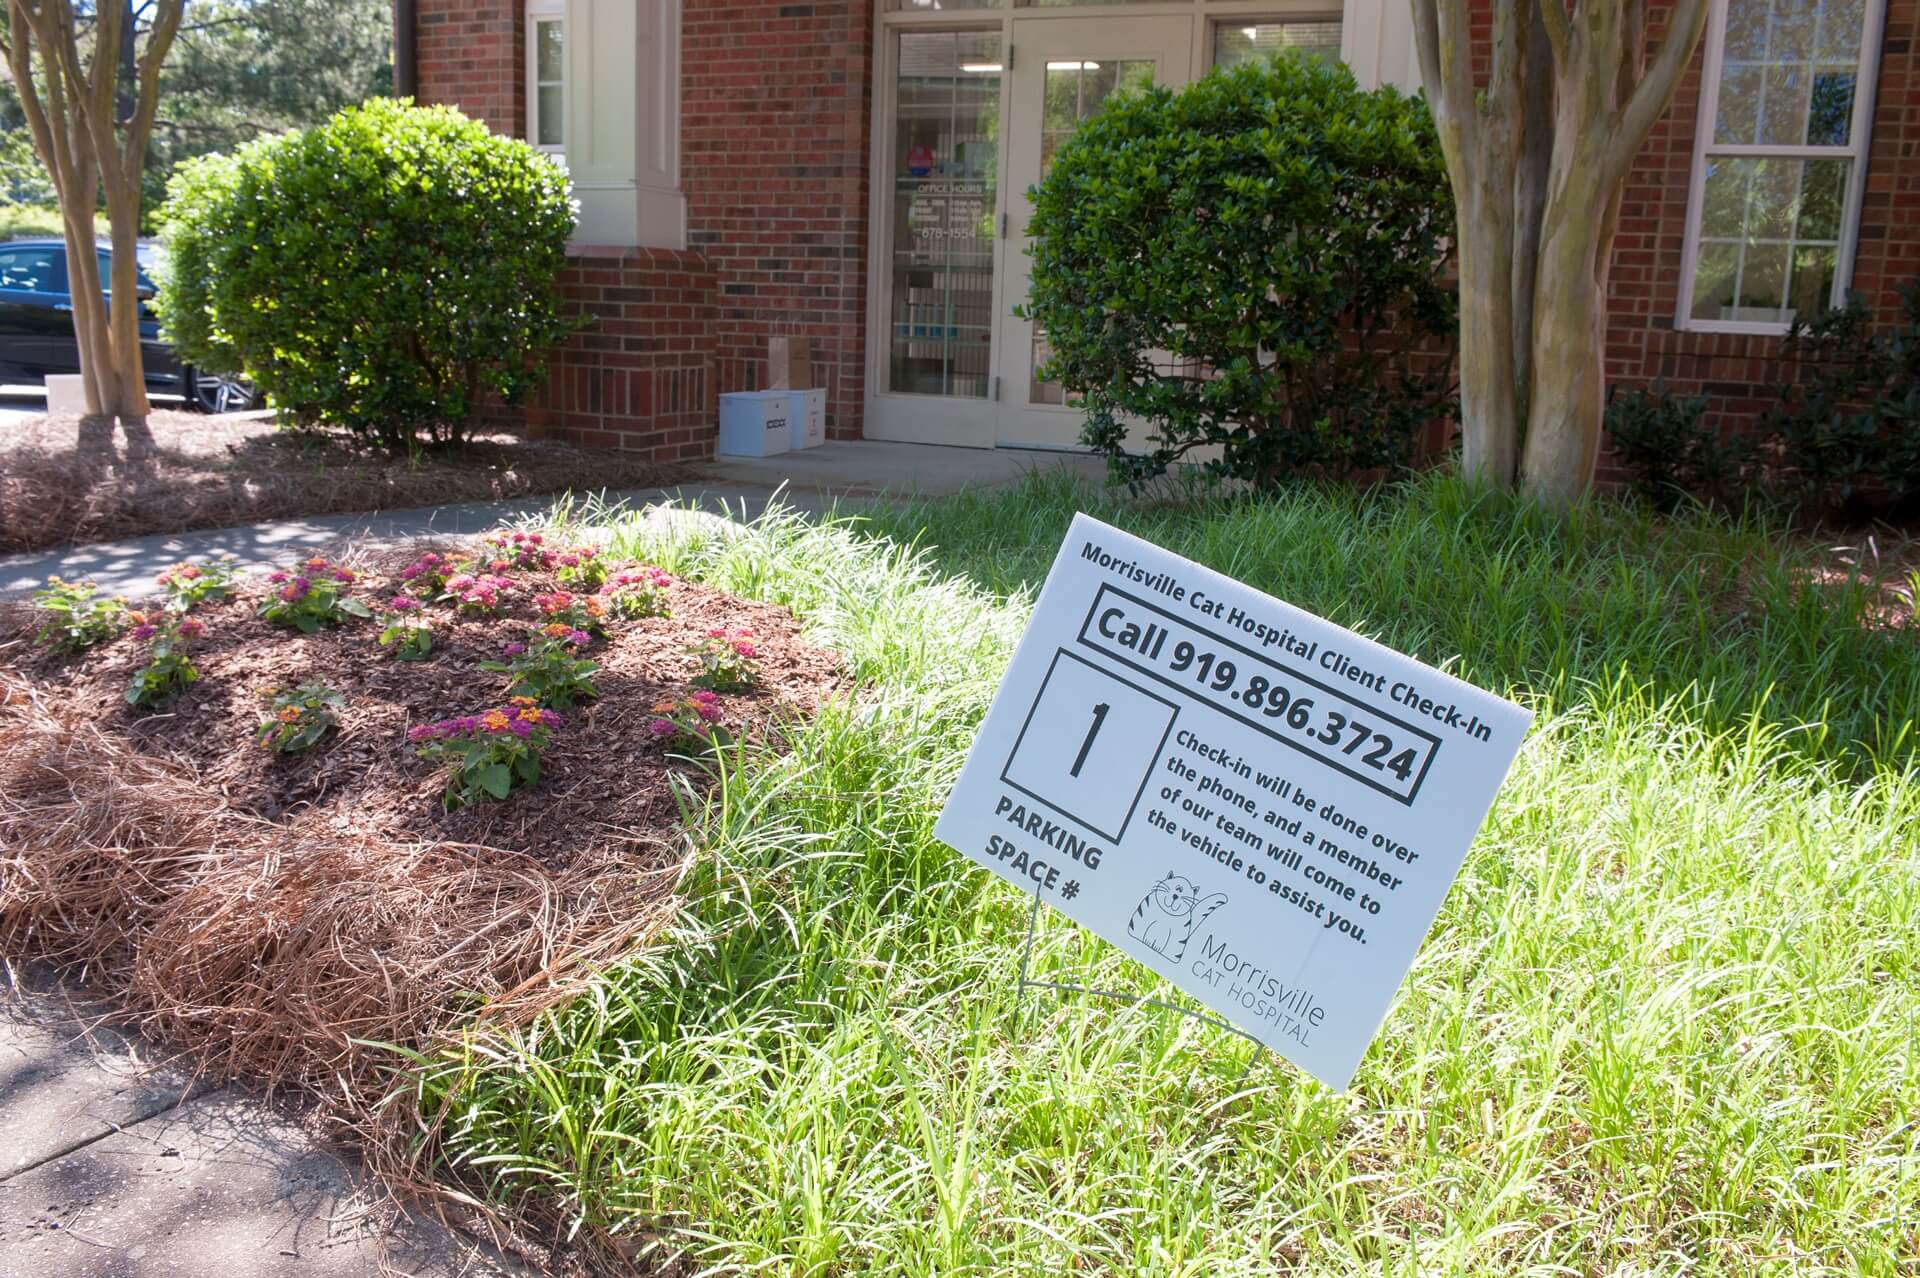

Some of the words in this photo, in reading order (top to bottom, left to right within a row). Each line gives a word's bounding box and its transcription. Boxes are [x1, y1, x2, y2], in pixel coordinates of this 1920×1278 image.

[1080, 541, 1186, 602] Morrisville
[1189, 591, 1225, 620] Cat
[1226, 607, 1319, 662] Hospital
[1319, 650, 1387, 694] Client
[1389, 682, 1492, 743] Check-In
[1098, 607, 1169, 661] Call
[1168, 640, 1418, 782] 919.896.3724
[1069, 702, 1111, 779] 1
[1176, 729, 1252, 780] Check-in
[1255, 771, 1292, 799] will
[1291, 787, 1317, 813] be
[1319, 804, 1369, 840] done
[1371, 833, 1420, 865] over
[984, 834, 1061, 891] SPACE
[1060, 879, 1081, 901] #
[994, 794, 1104, 871] PARKING
[1147, 808, 1177, 835] the
[1181, 827, 1244, 873] vehicle
[1246, 864, 1267, 885] to
[1268, 879, 1326, 919] assist
[1323, 910, 1367, 945] you.
[1160, 786, 1183, 804] of
[1181, 798, 1215, 822] our
[1215, 814, 1264, 851] team
[1266, 842, 1304, 872] will
[1303, 865, 1356, 902] come
[1359, 893, 1382, 915] to
[1166, 756, 1197, 783] the
[1196, 775, 1259, 819] phone,
[1263, 810, 1303, 838] and
[1302, 831, 1316, 847] a
[1317, 838, 1403, 892] member
[1191, 960, 1225, 988] CAT
[1227, 982, 1309, 1048] HOSPITAL
[1200, 933, 1325, 1027] Morrisville
